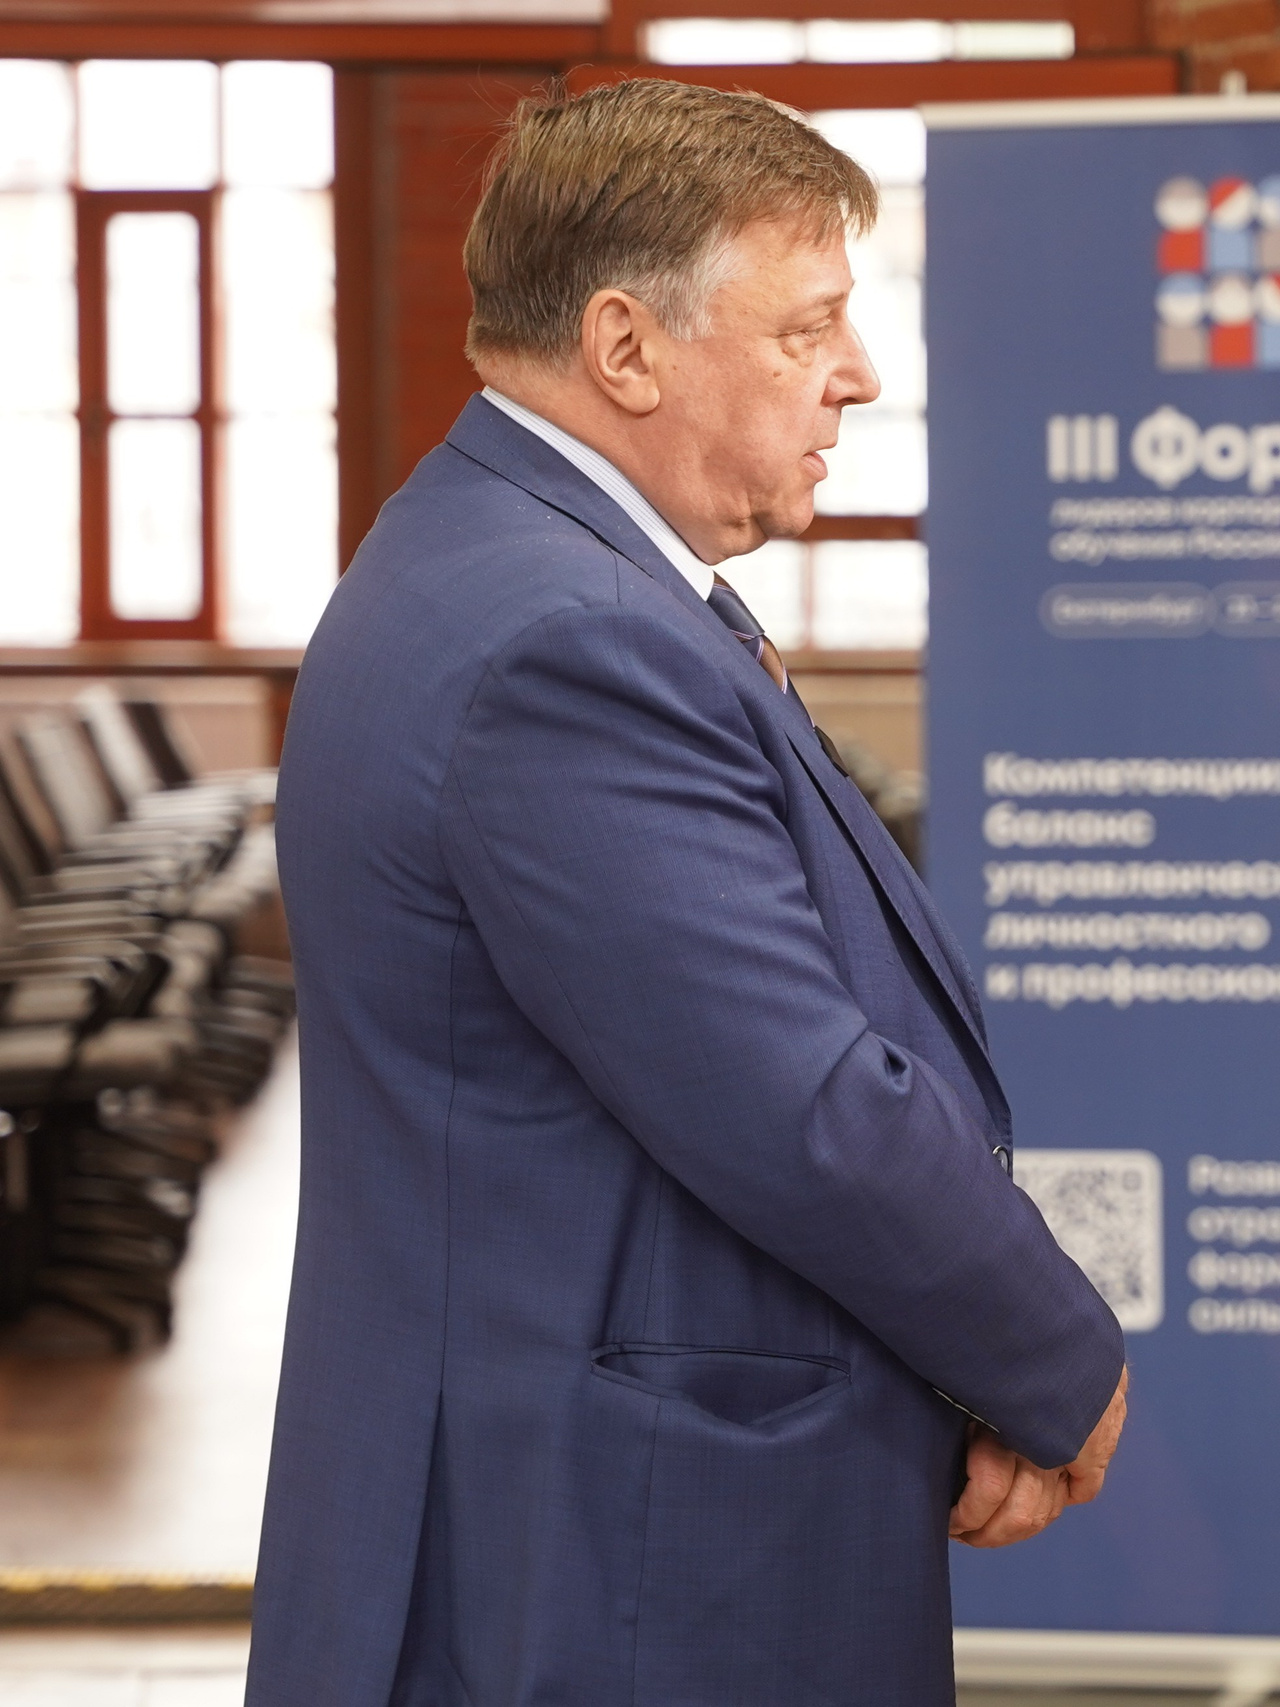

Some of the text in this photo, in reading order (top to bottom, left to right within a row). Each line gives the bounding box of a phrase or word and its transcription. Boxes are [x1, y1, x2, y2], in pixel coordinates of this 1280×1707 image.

[1047, 414, 1118, 482] III
[983, 802, 1155, 847] баланс
[984, 912, 1270, 951] личностного
[986, 964, 1018, 1000] и
